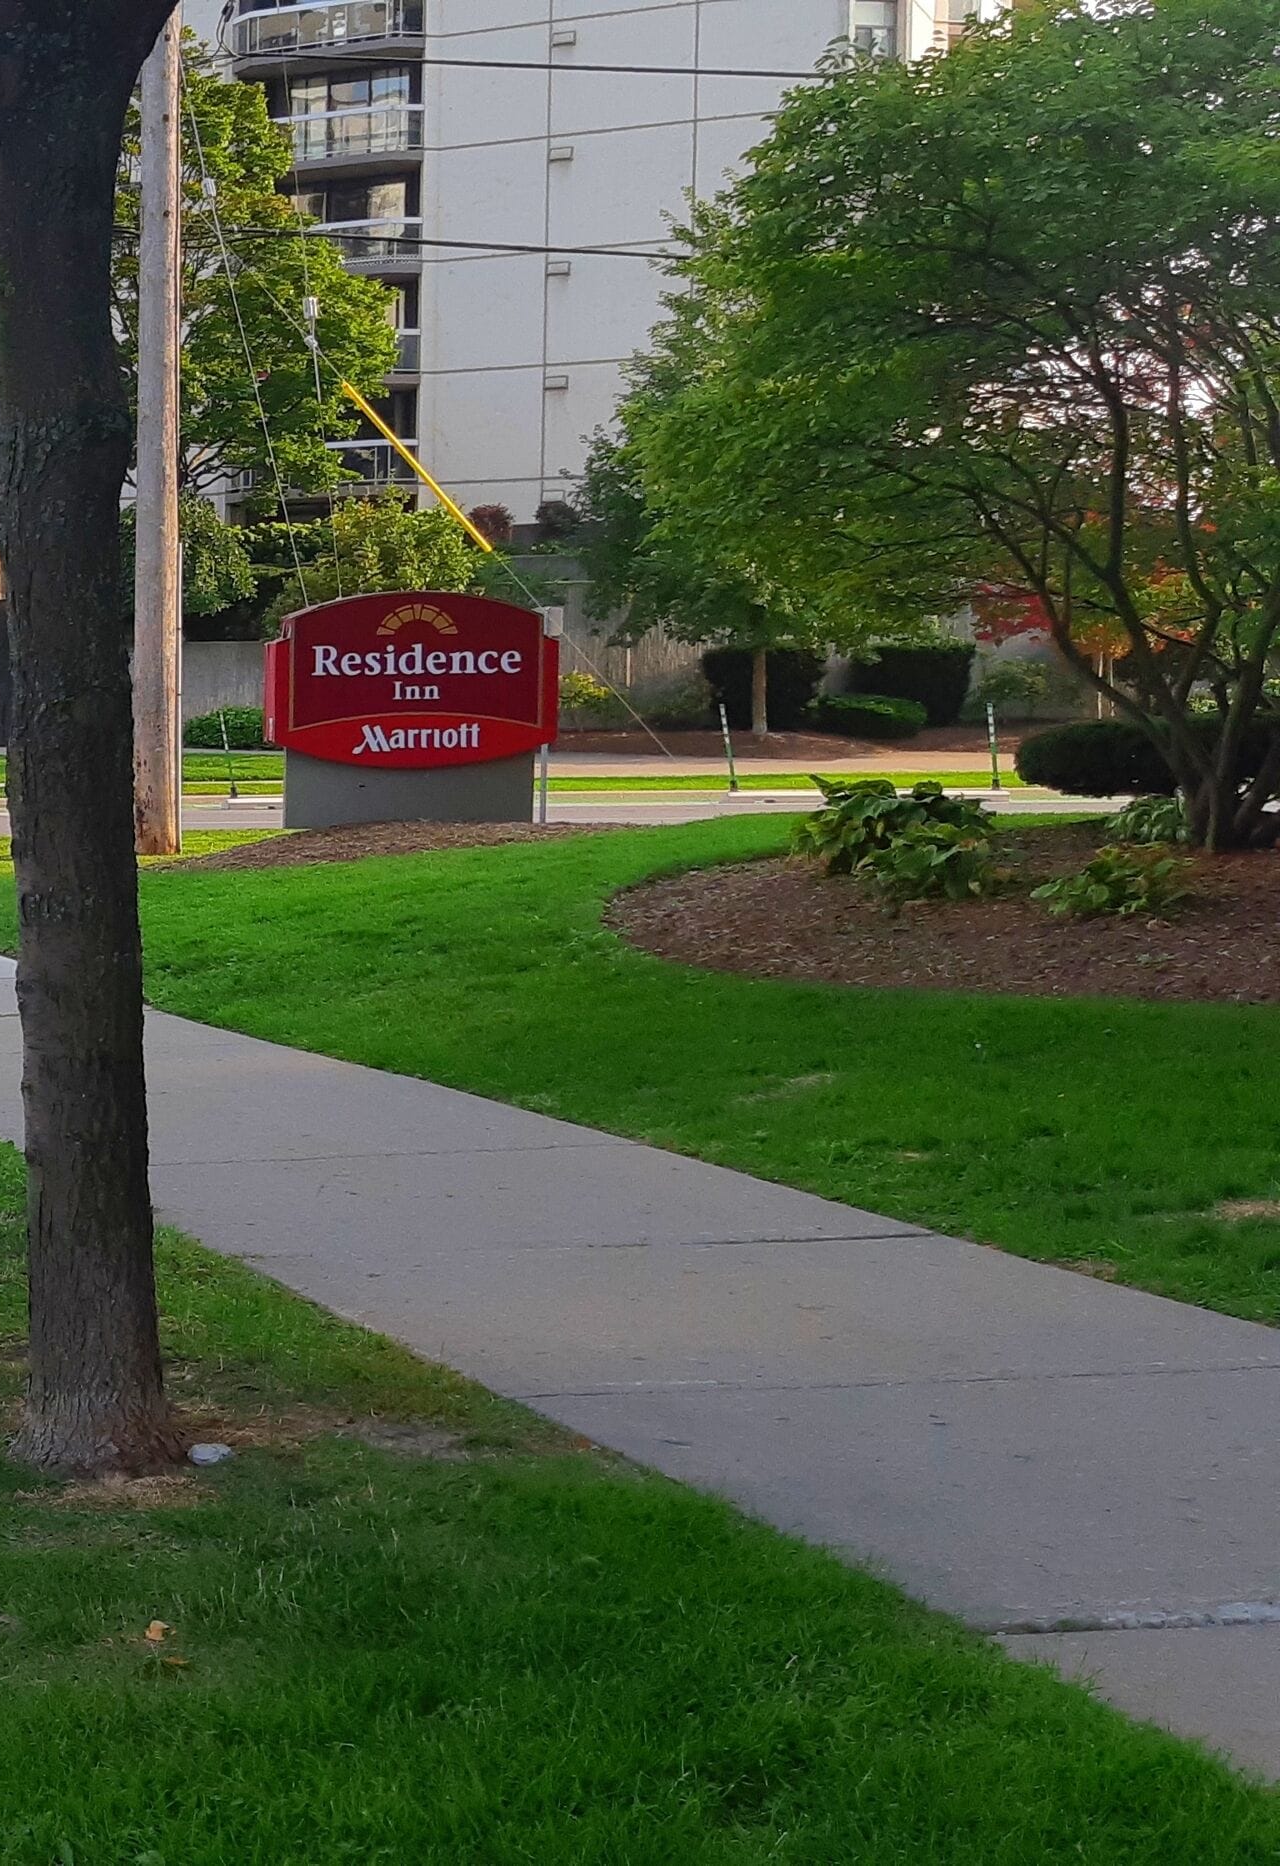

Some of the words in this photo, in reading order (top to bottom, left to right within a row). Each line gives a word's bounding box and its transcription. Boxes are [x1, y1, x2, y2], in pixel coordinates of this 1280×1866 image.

[311, 643, 522, 676] Residence
[392, 681, 440, 700] Inn
[352, 723, 481, 755] Marriott
